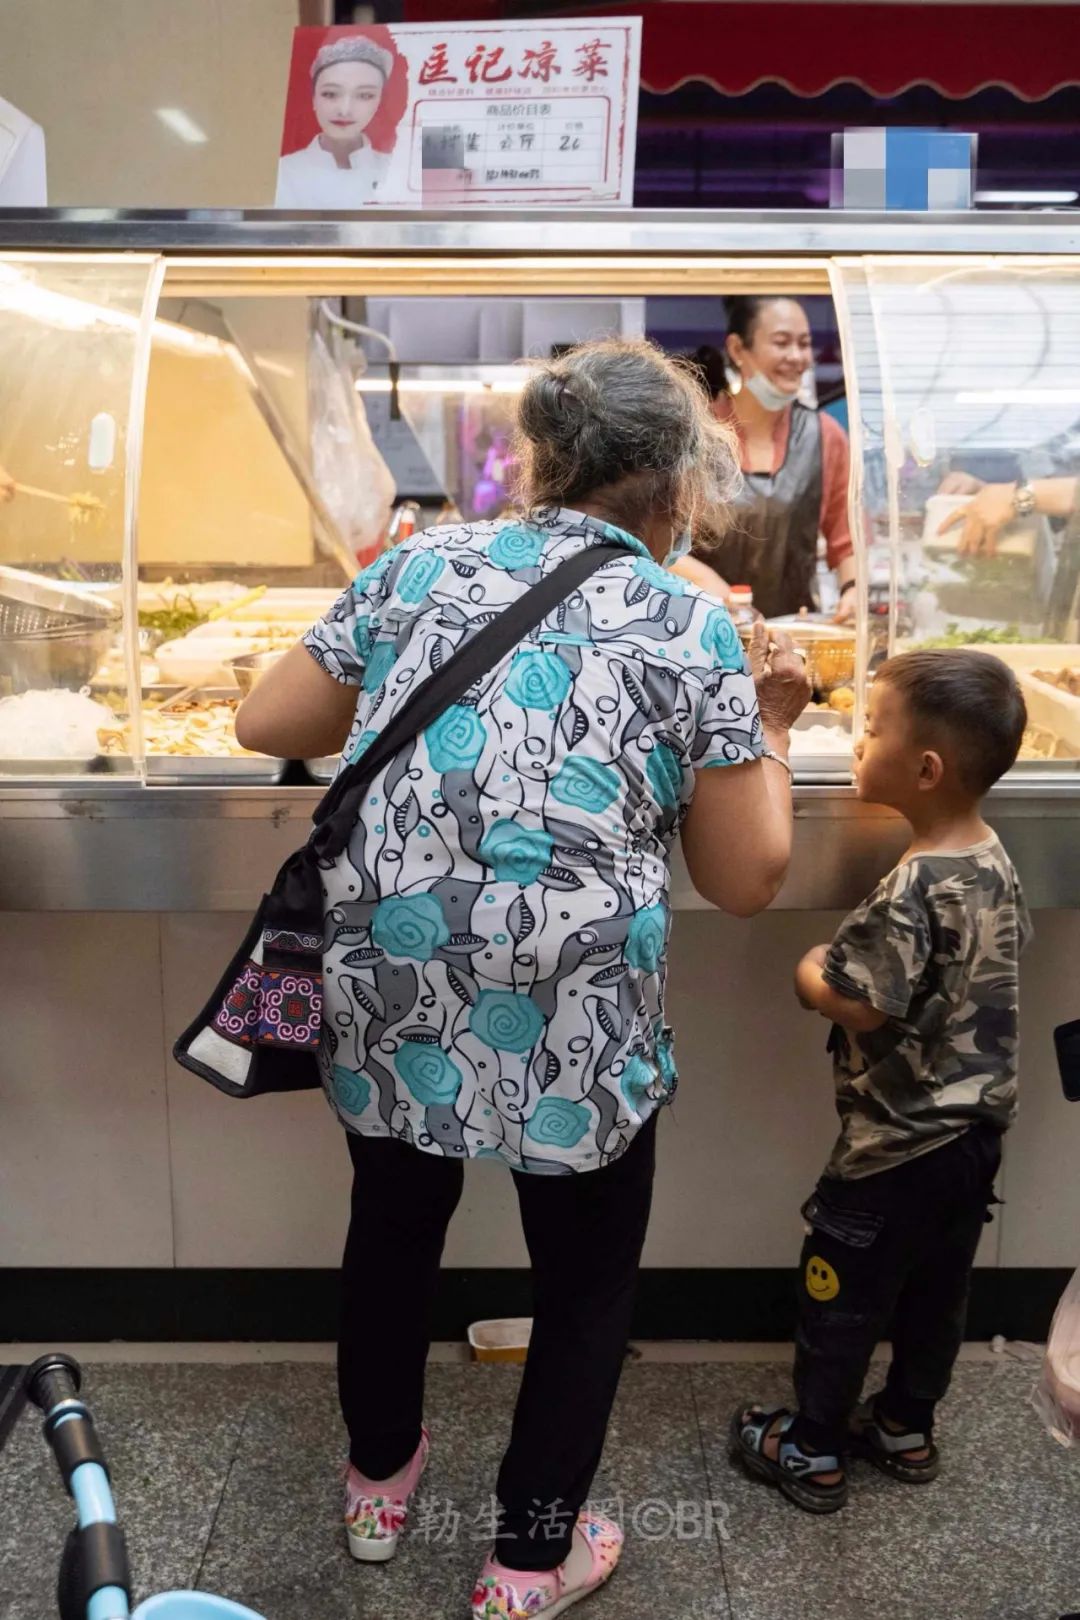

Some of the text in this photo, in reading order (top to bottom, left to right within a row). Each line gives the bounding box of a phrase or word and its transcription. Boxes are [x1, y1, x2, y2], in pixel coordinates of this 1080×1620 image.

[418, 38, 612, 85] 匡记凉菜
[486, 103, 552, 117] 商品价目表
